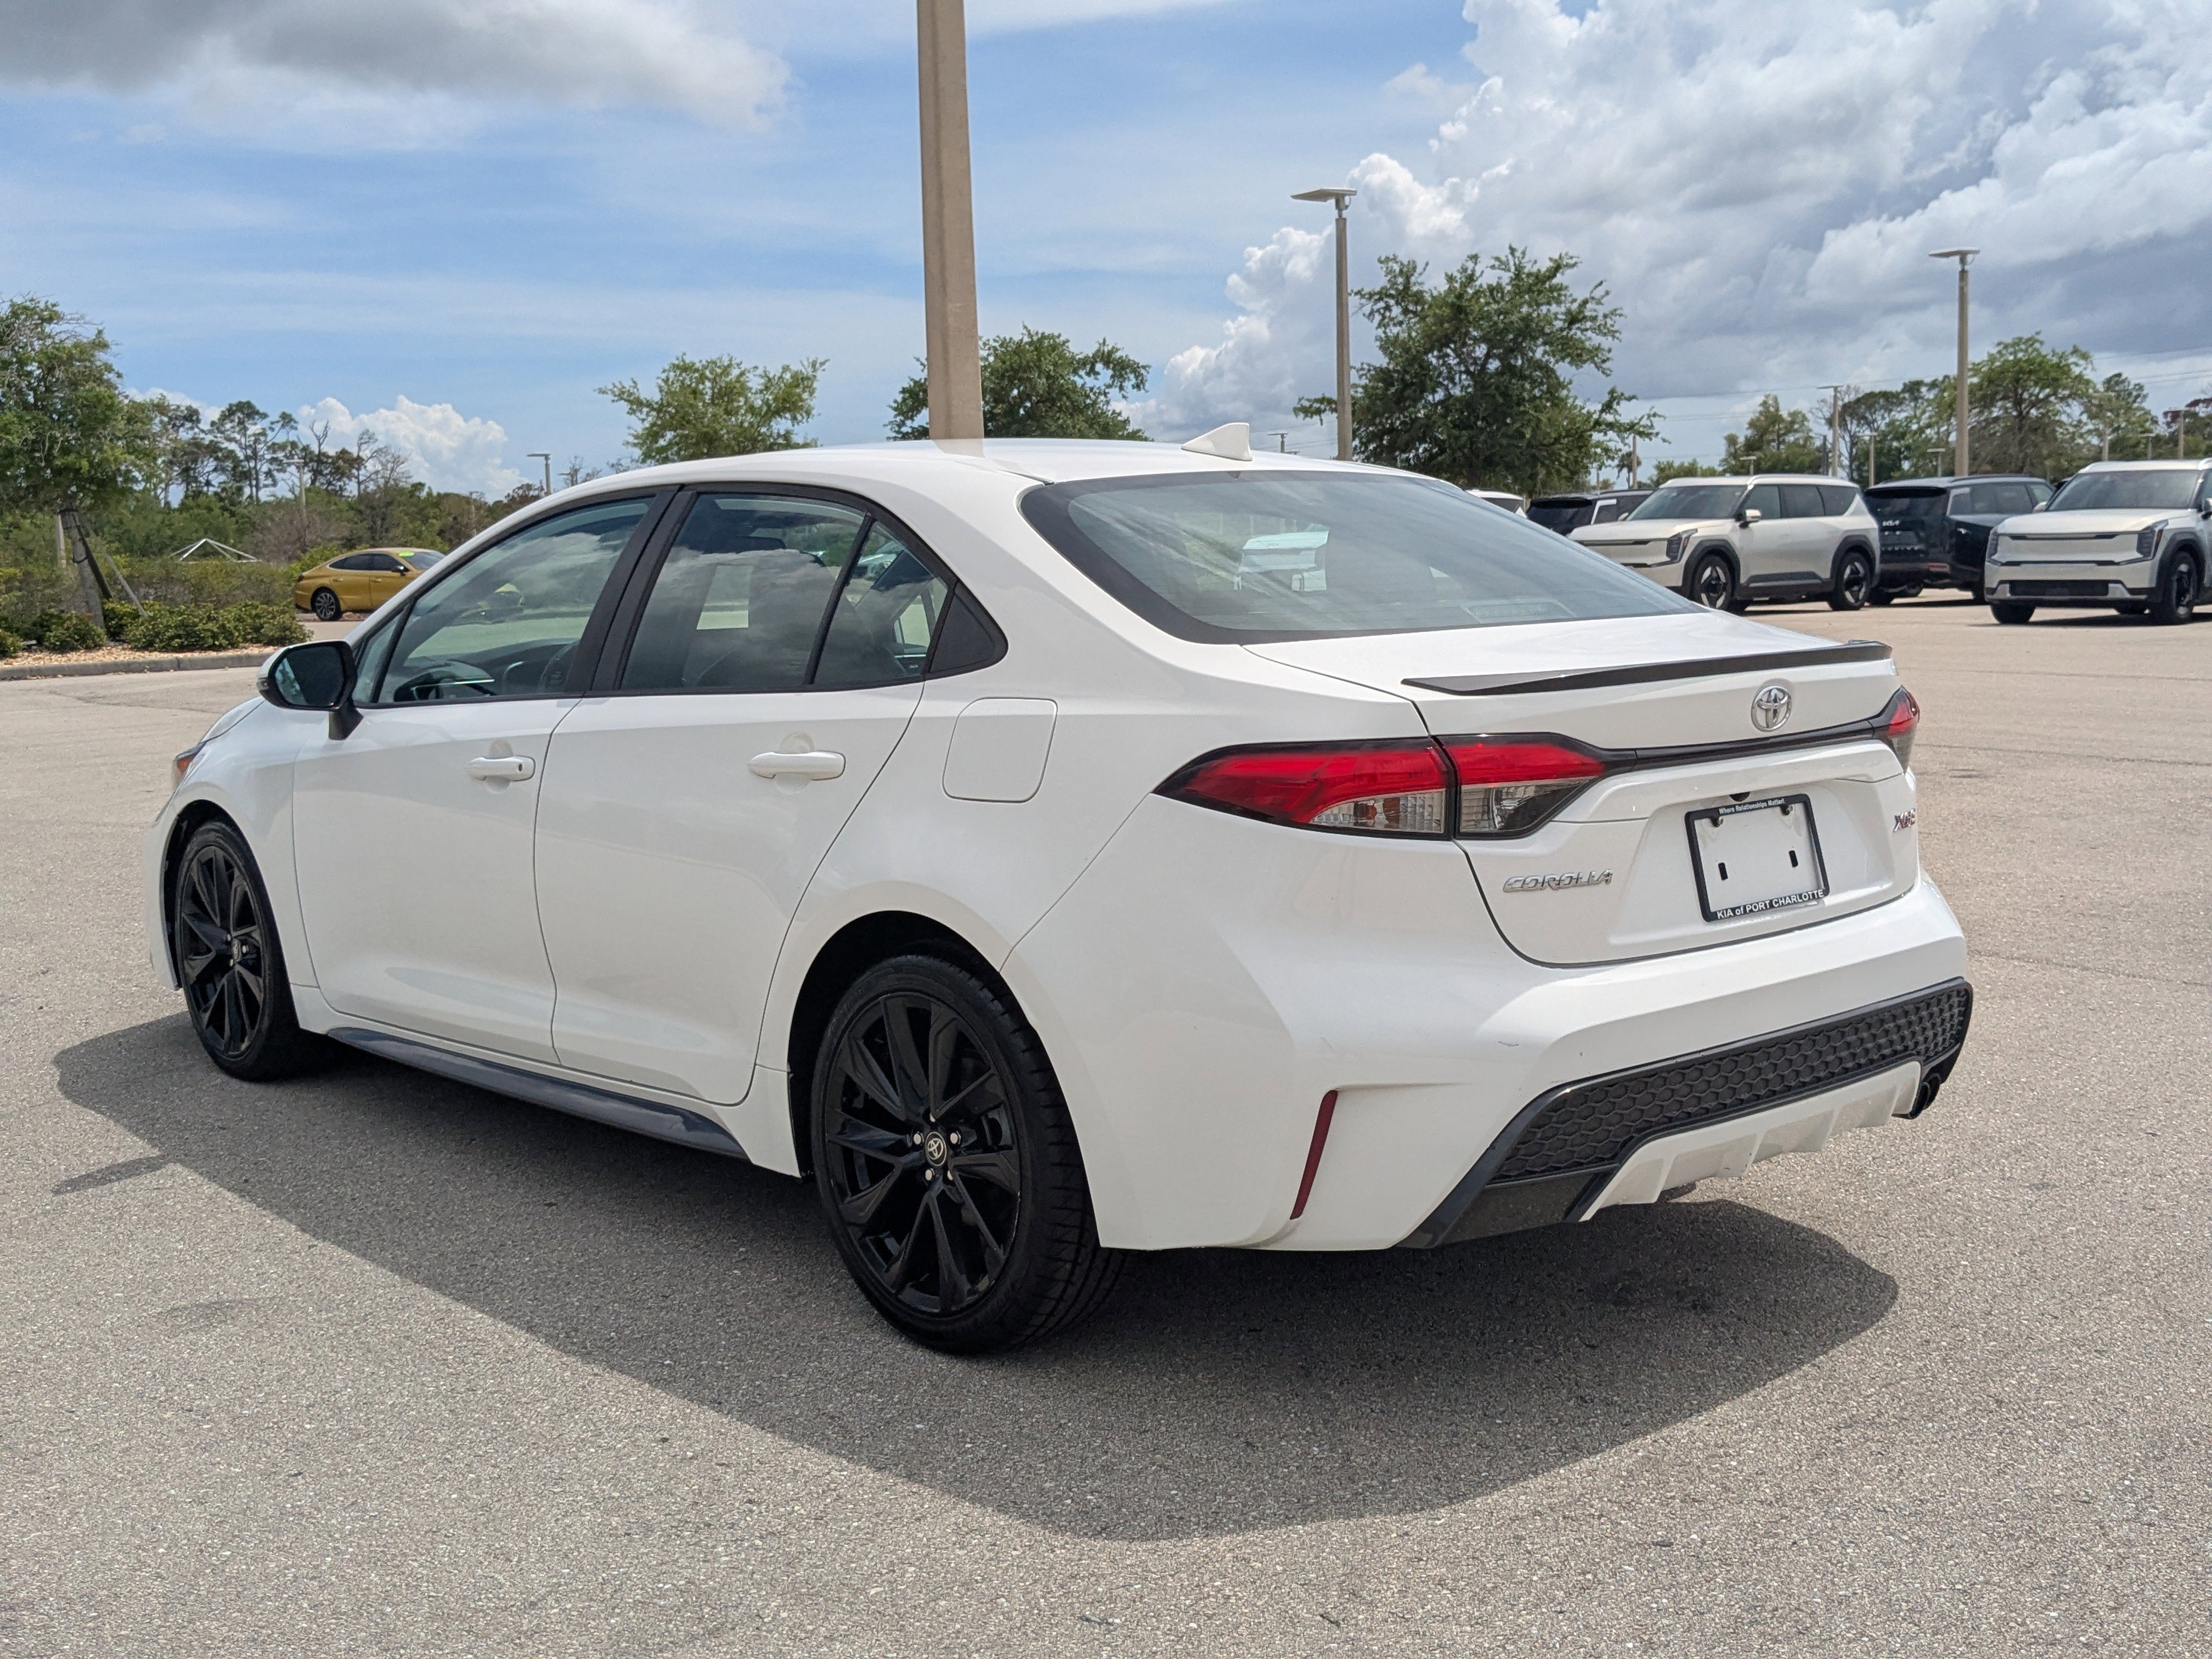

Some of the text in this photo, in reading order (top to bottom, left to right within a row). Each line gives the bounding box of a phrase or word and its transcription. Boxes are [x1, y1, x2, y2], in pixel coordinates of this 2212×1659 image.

[1735, 802, 1767, 811] Relationships
[1503, 868, 1613, 893] COROLLA
[1717, 889, 1824, 919] KIA of PORT CHARLOTTE
